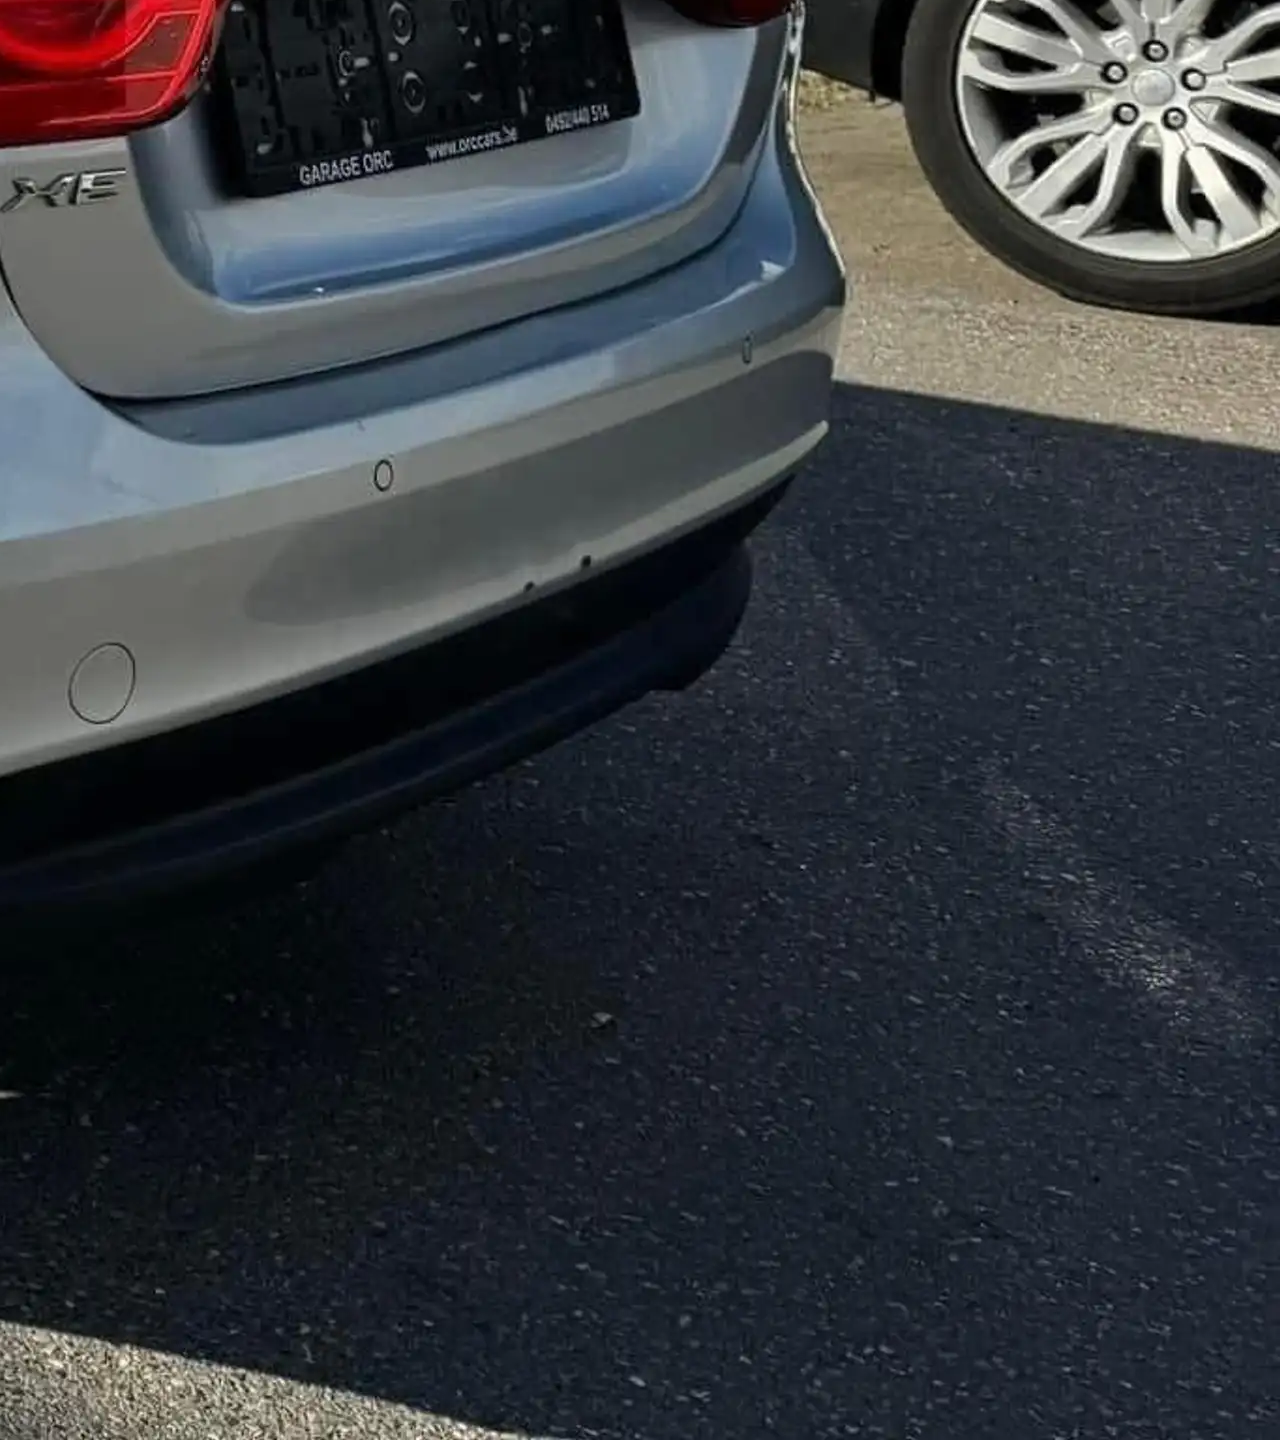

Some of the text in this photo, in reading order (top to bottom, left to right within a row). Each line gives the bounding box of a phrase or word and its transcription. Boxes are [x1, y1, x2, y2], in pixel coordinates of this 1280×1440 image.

[299, 156, 361, 186] GARAGE
[363, 150, 394, 176] ORC
[425, 125, 518, 160] www.orccars.be
[0, 167, 127, 212] XE
